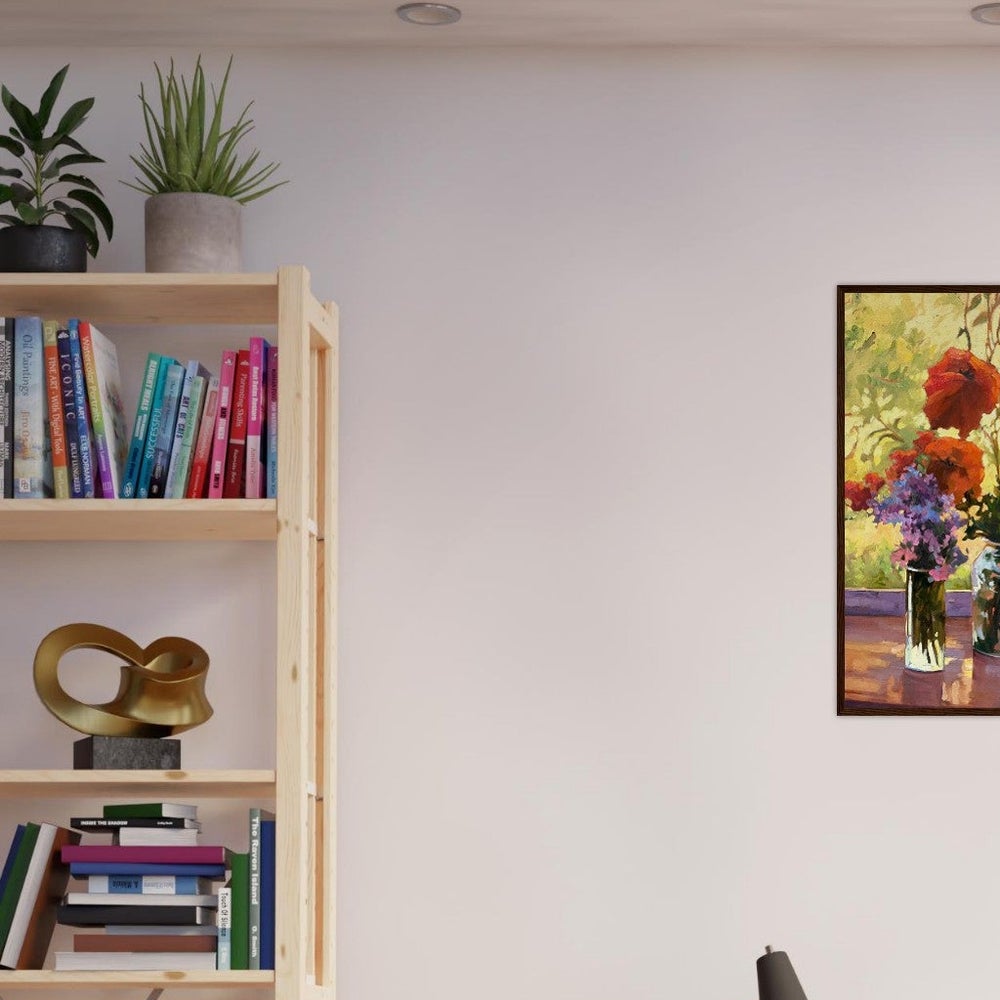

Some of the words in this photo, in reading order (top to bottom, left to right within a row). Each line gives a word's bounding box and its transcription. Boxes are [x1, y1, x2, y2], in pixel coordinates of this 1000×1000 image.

[23, 334, 33, 348] Oil
[19, 352, 31, 396] Paintings
[48, 356, 56, 375] FINE
[61, 354, 76, 419] ICONIC
[82, 336, 96, 384] Watercolor
[90, 386, 101, 423] Portraits
[237, 373, 247, 407] Parenting
[52, 396, 60, 413] With
[50, 414, 61, 436] Digital
[236, 408, 245, 427] Skills
[146, 408, 162, 459] SUCCESSFUL
[54, 438, 62, 454] Tools
